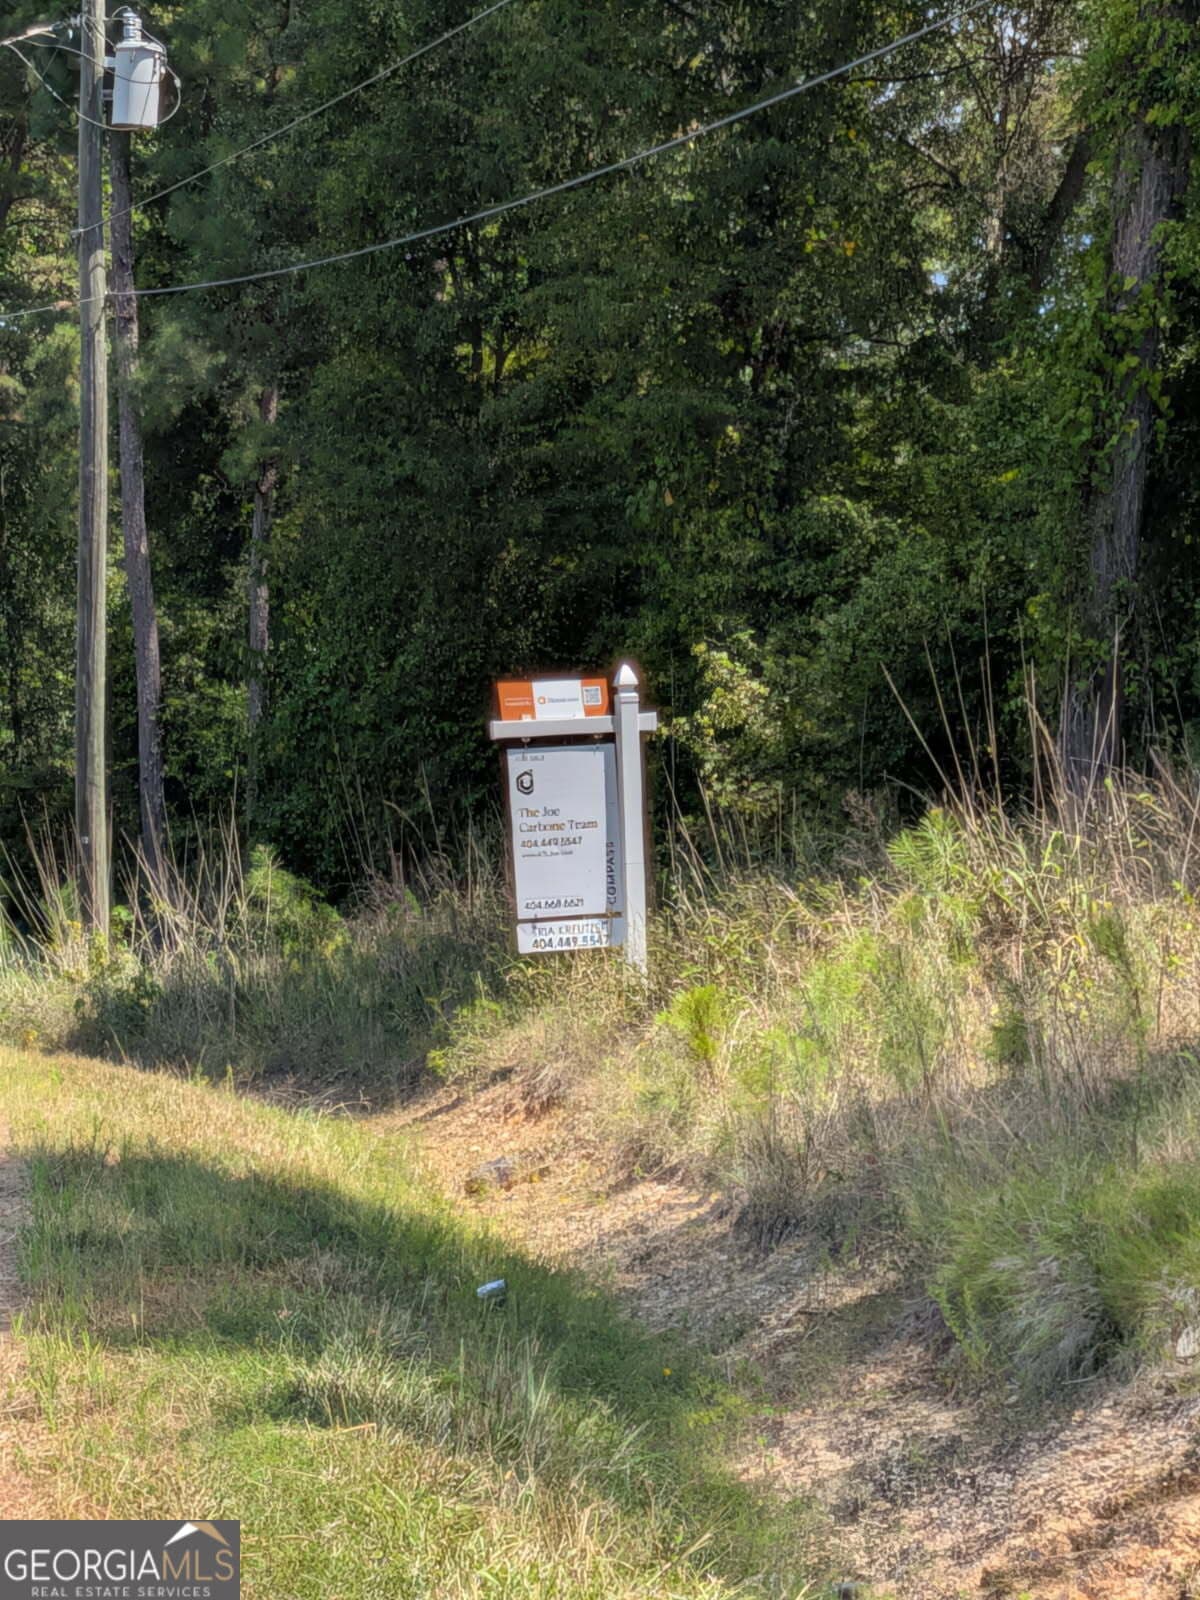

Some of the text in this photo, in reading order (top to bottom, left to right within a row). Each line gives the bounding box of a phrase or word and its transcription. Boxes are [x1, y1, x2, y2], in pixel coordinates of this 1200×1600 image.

[519, 806, 560, 818] The Joe
[519, 819, 598, 833] Carbone Team
